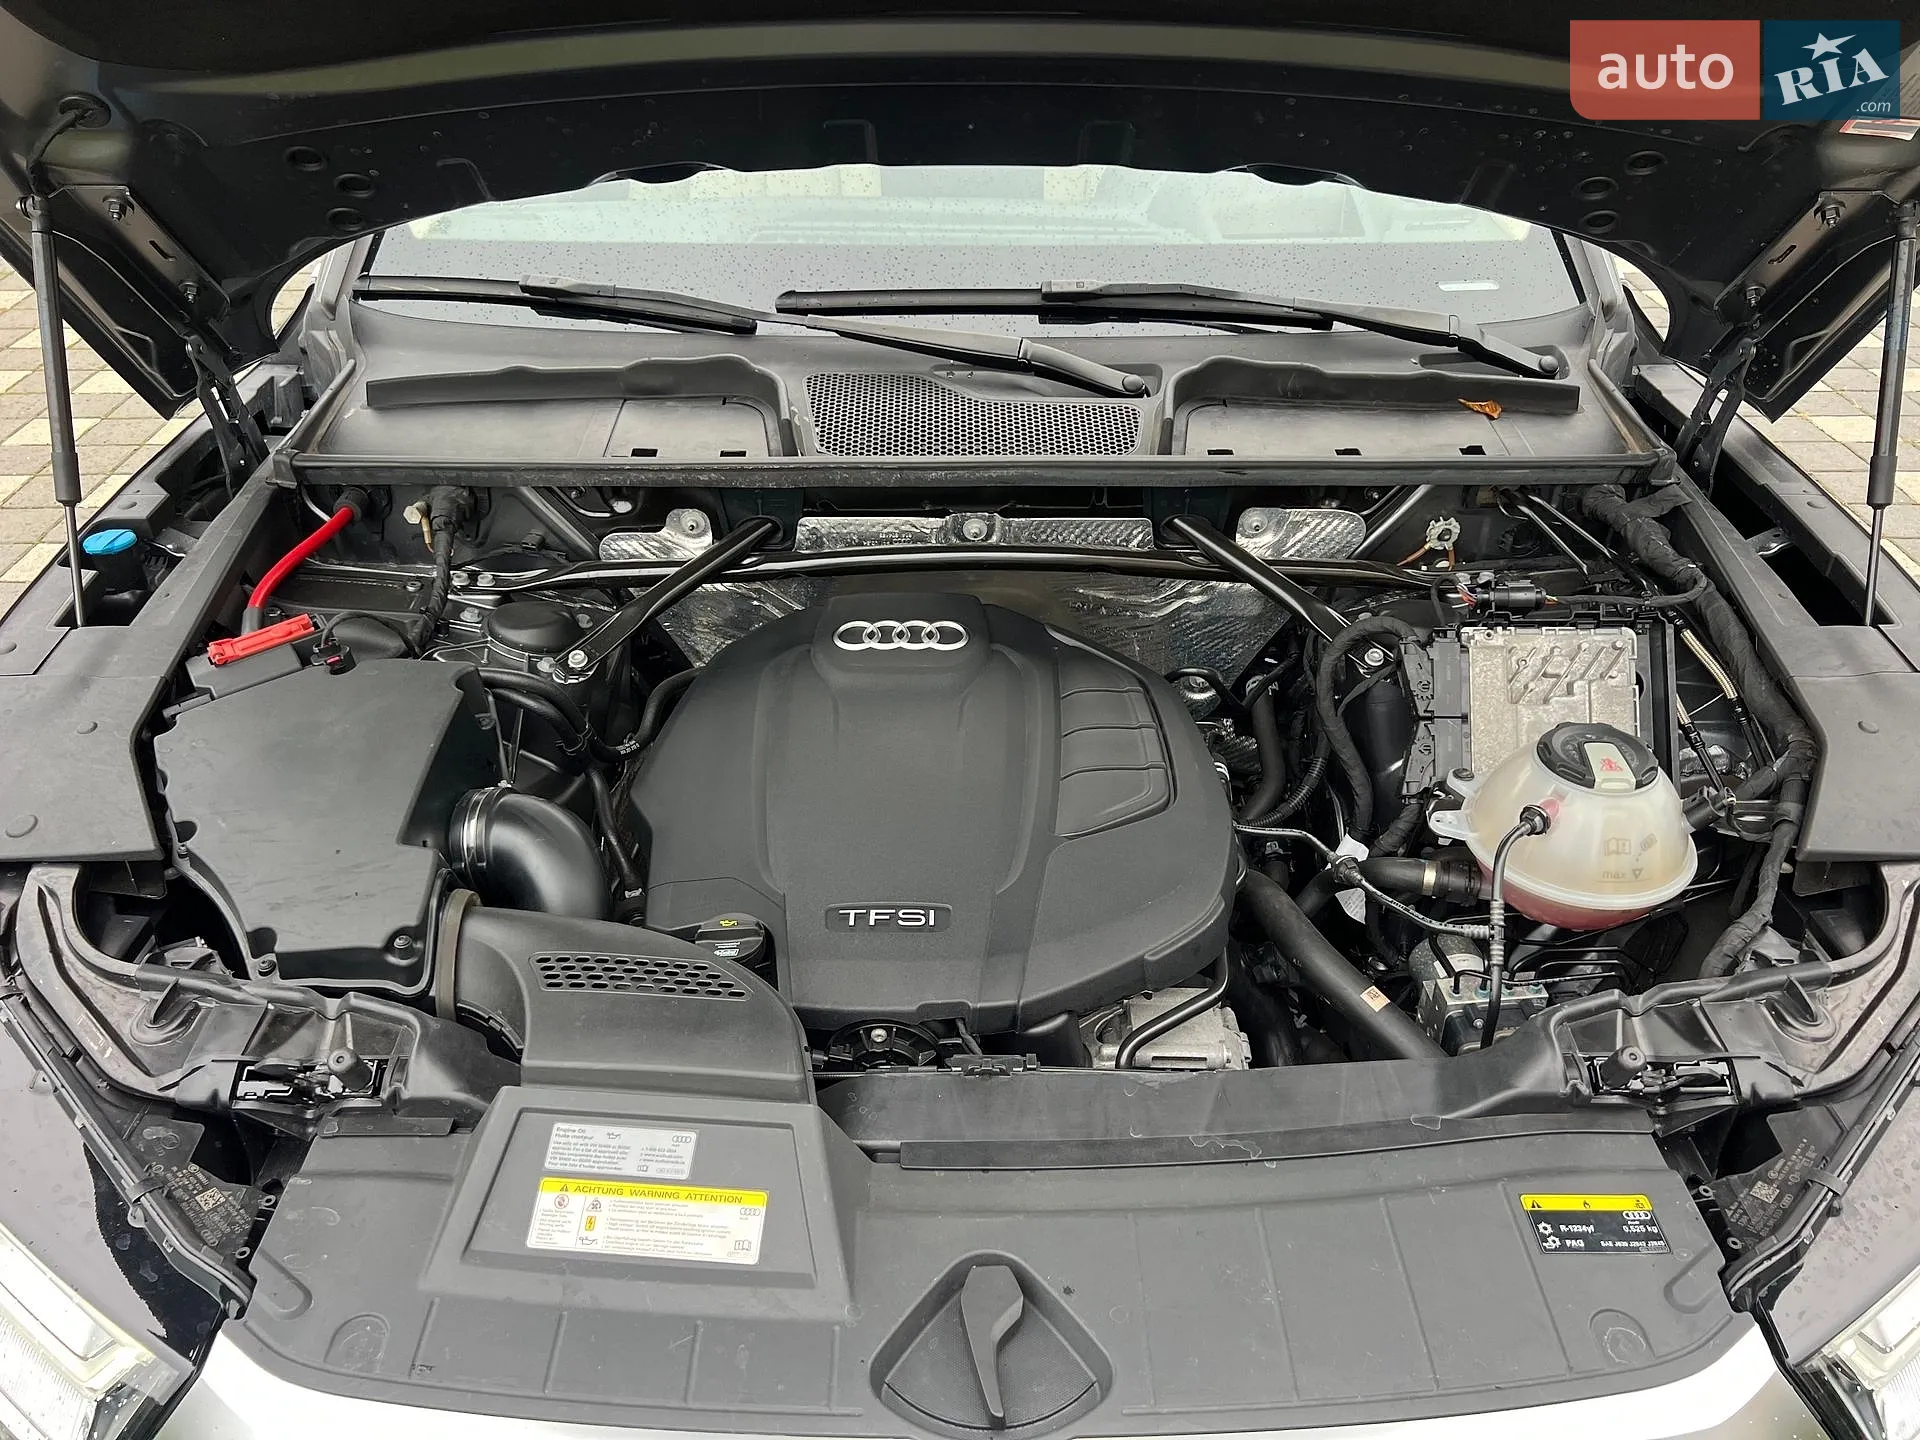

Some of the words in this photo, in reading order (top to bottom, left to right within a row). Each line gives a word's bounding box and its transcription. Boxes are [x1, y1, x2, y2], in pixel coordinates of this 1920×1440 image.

[838, 909, 936, 927] TFSI
[573, 1185, 624, 1196] ACHTUNG
[629, 1189, 680, 1199] WARNING
[685, 1192, 743, 1204] ATTENTION
[1646, 1225, 1659, 1234] kg
[1565, 1239, 1585, 1248] PAG
